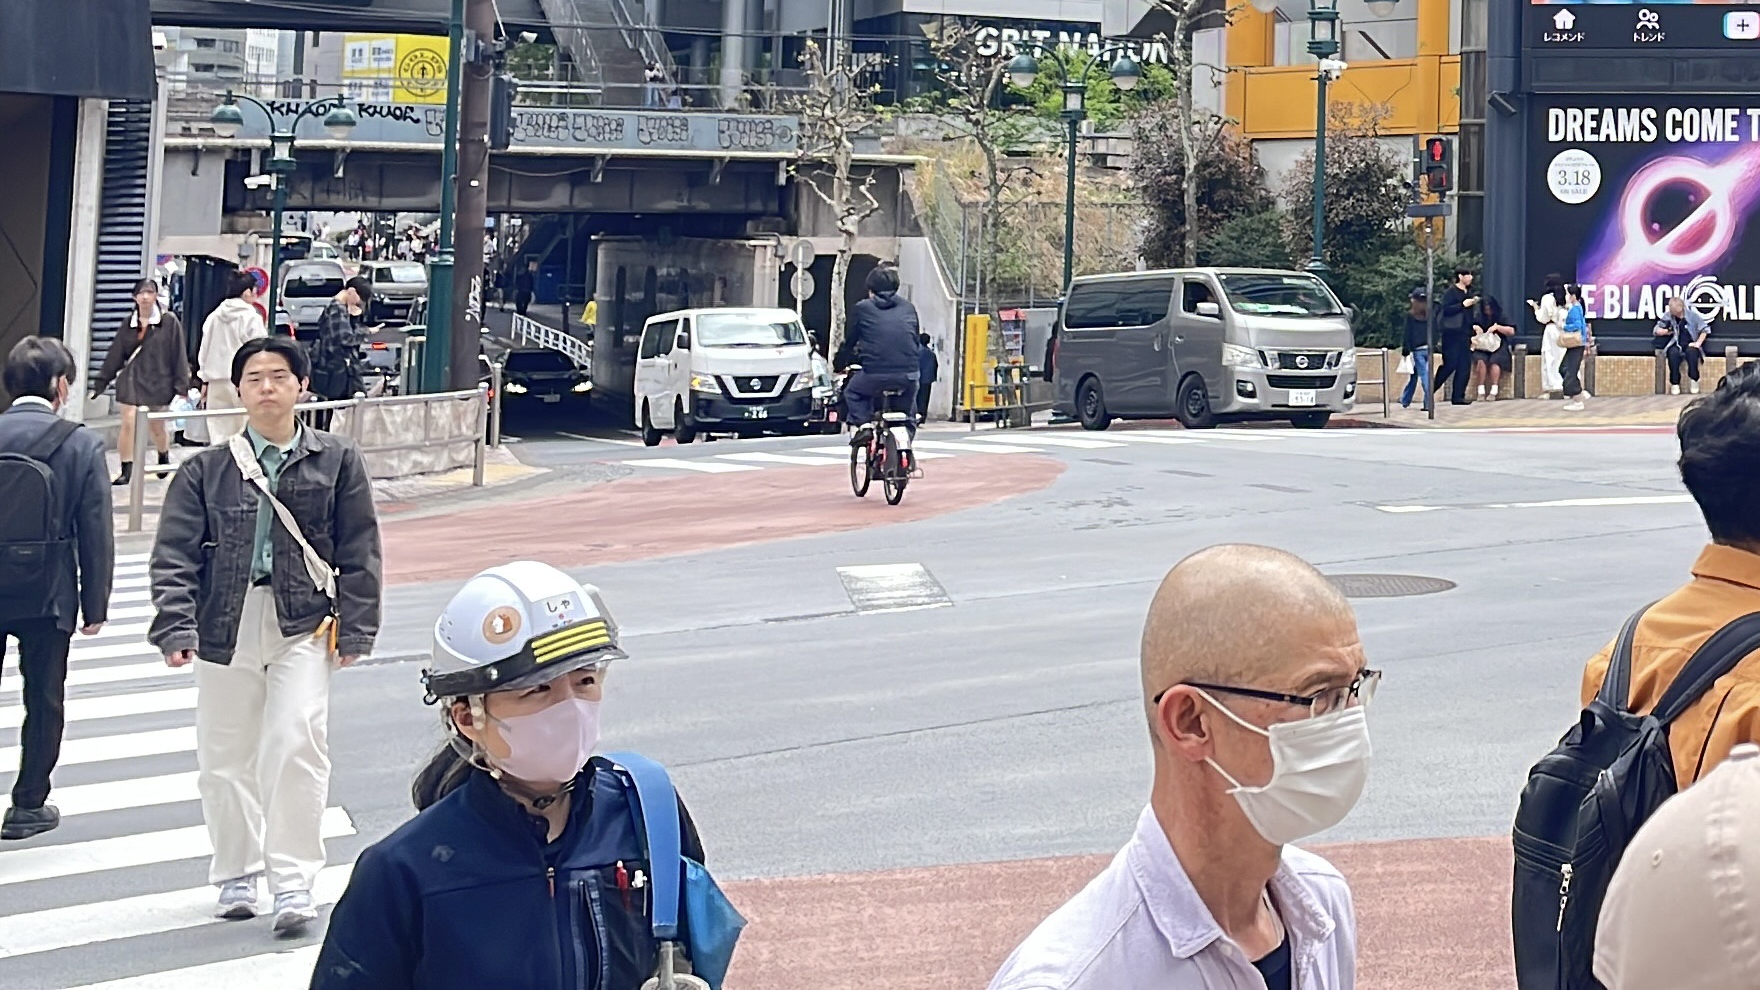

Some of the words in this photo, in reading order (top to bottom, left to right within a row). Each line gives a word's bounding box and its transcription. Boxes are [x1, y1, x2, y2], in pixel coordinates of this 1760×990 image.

[1543, 31, 1586, 43] レコメンド
[1633, 31, 1666, 43] トレンド
[1547, 107, 1657, 143] DREAMS
[1664, 107, 1740, 143] COME
[1558, 169, 1591, 186] 3.18
[1603, 284, 1682, 320] BLAC
